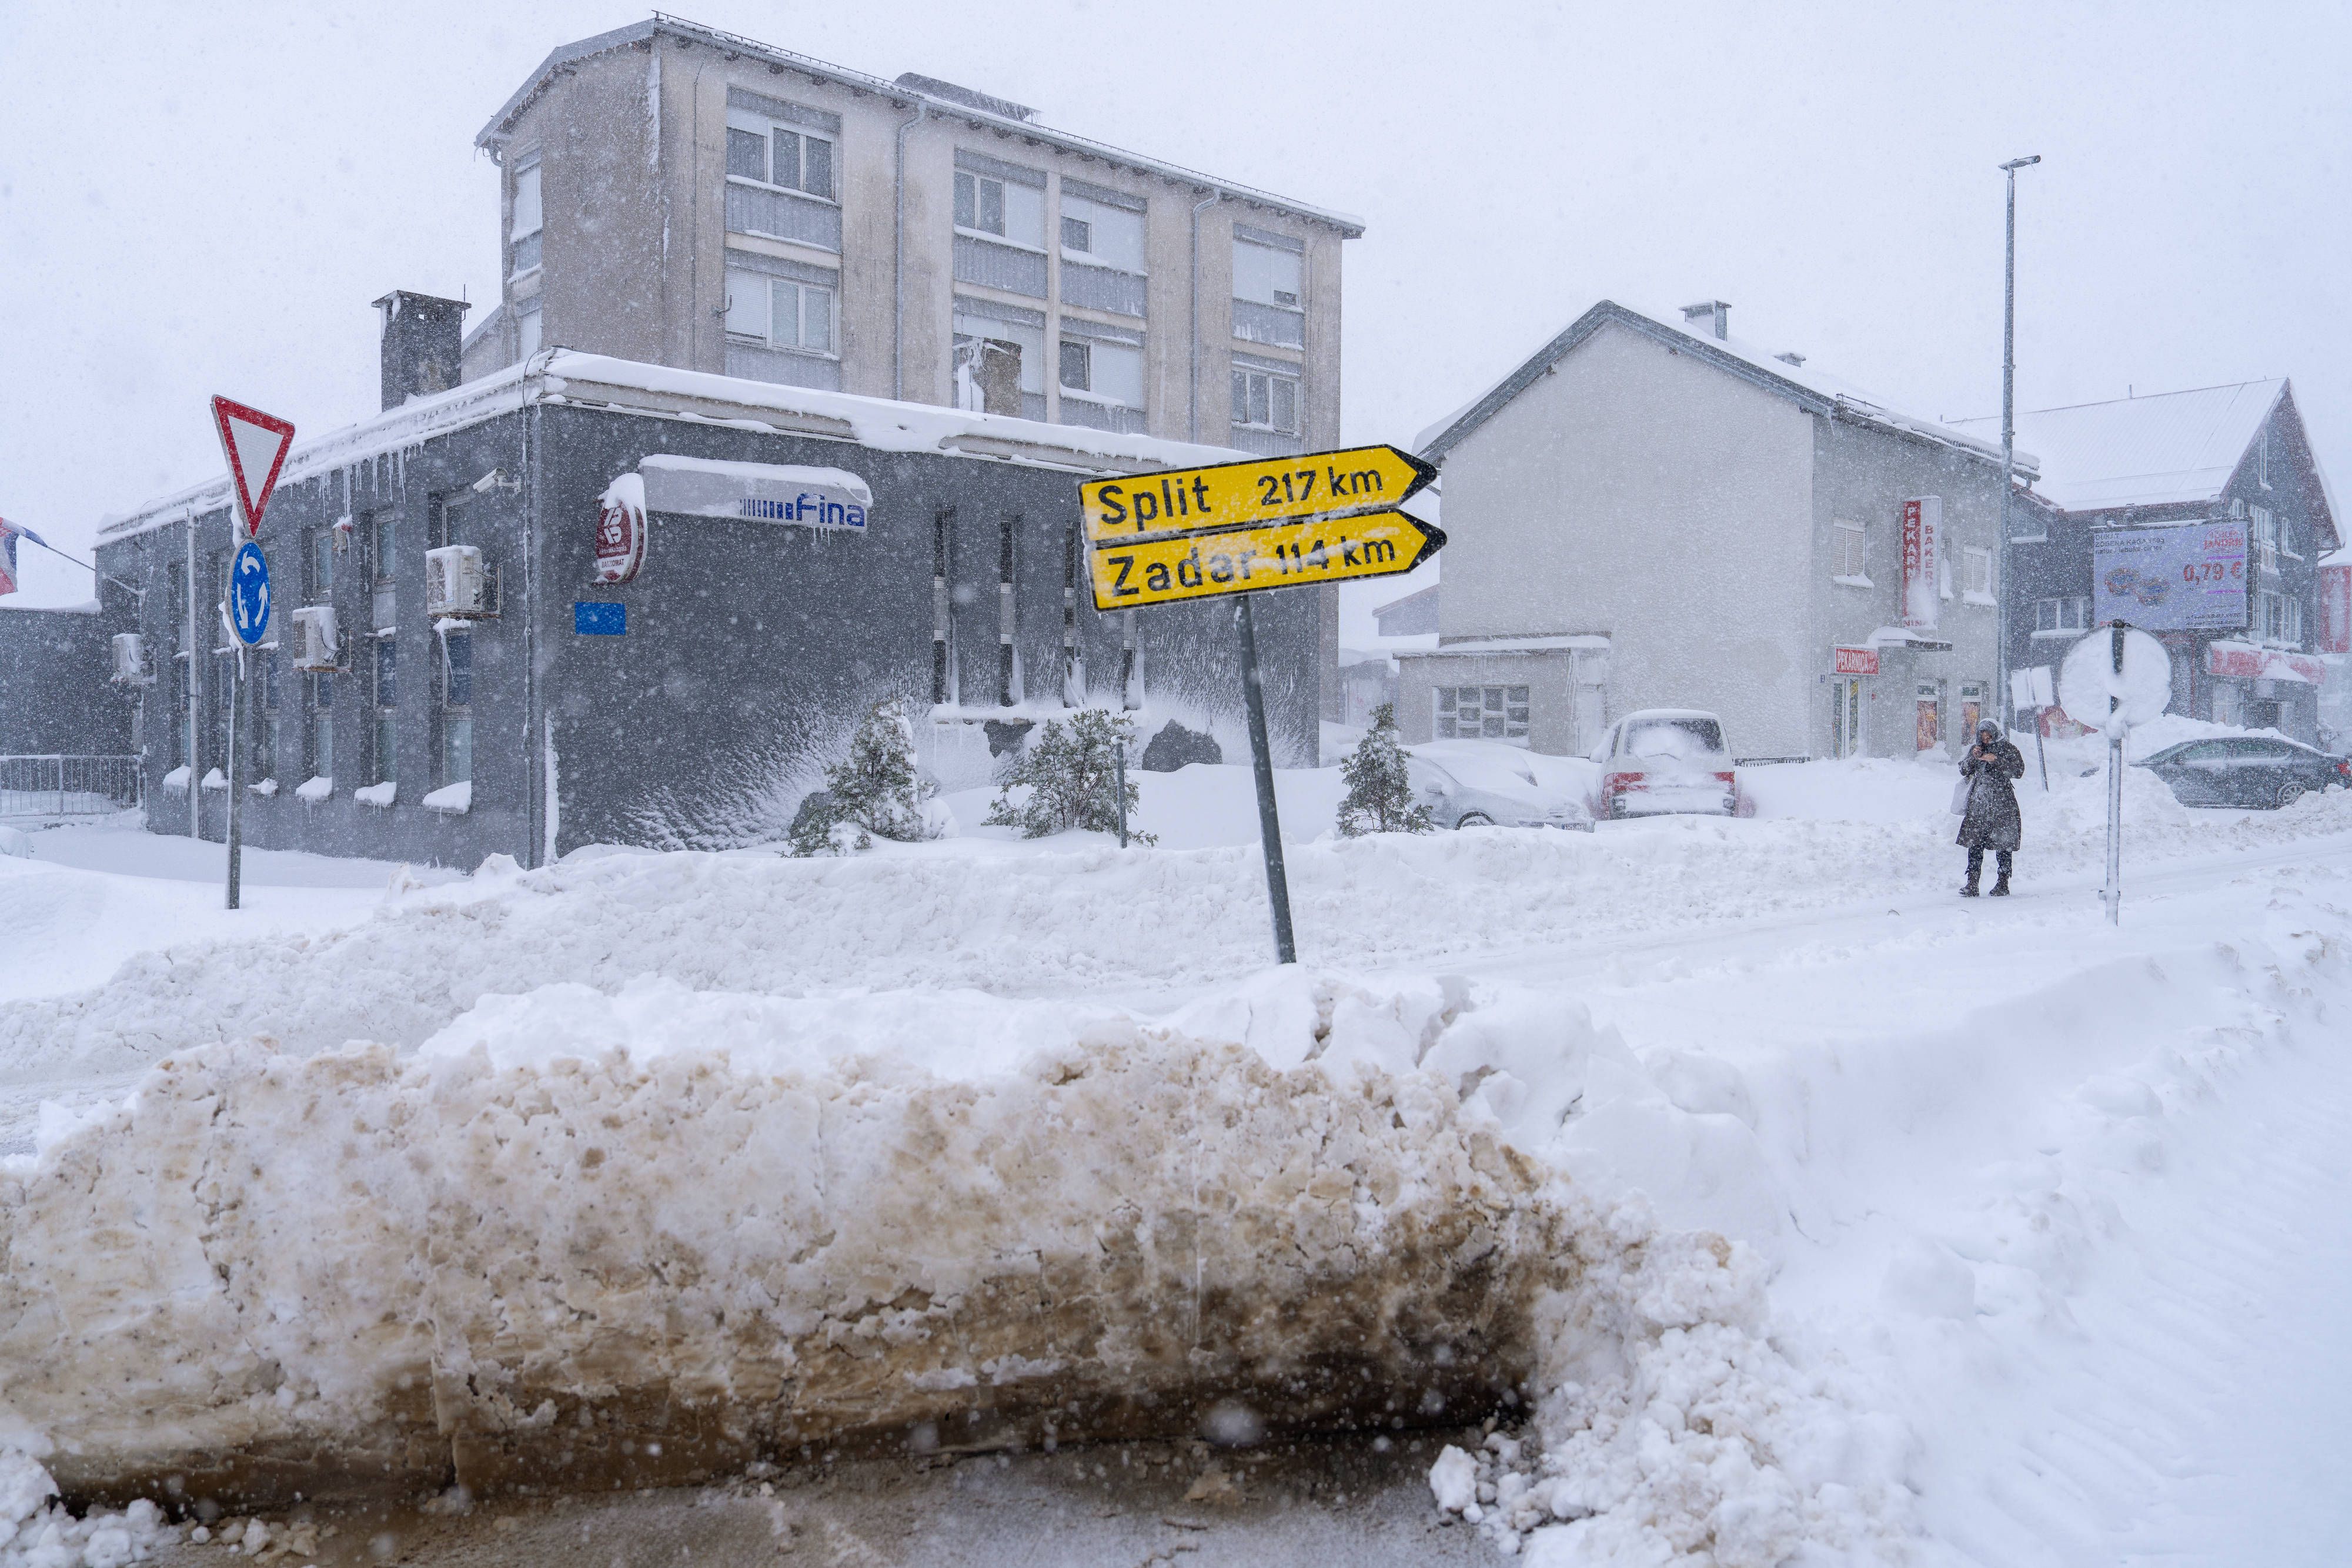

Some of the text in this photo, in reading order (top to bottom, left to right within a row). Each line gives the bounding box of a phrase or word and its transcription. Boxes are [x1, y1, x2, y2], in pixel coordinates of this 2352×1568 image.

[1098, 466, 1383, 531] Split 217 km
[602, 559, 624, 568] BANOMAT
[1107, 536, 1396, 597] Zadar 114 km
[2183, 562, 2224, 586] 0,79
[1838, 650, 1868, 671] PEKARNICA
